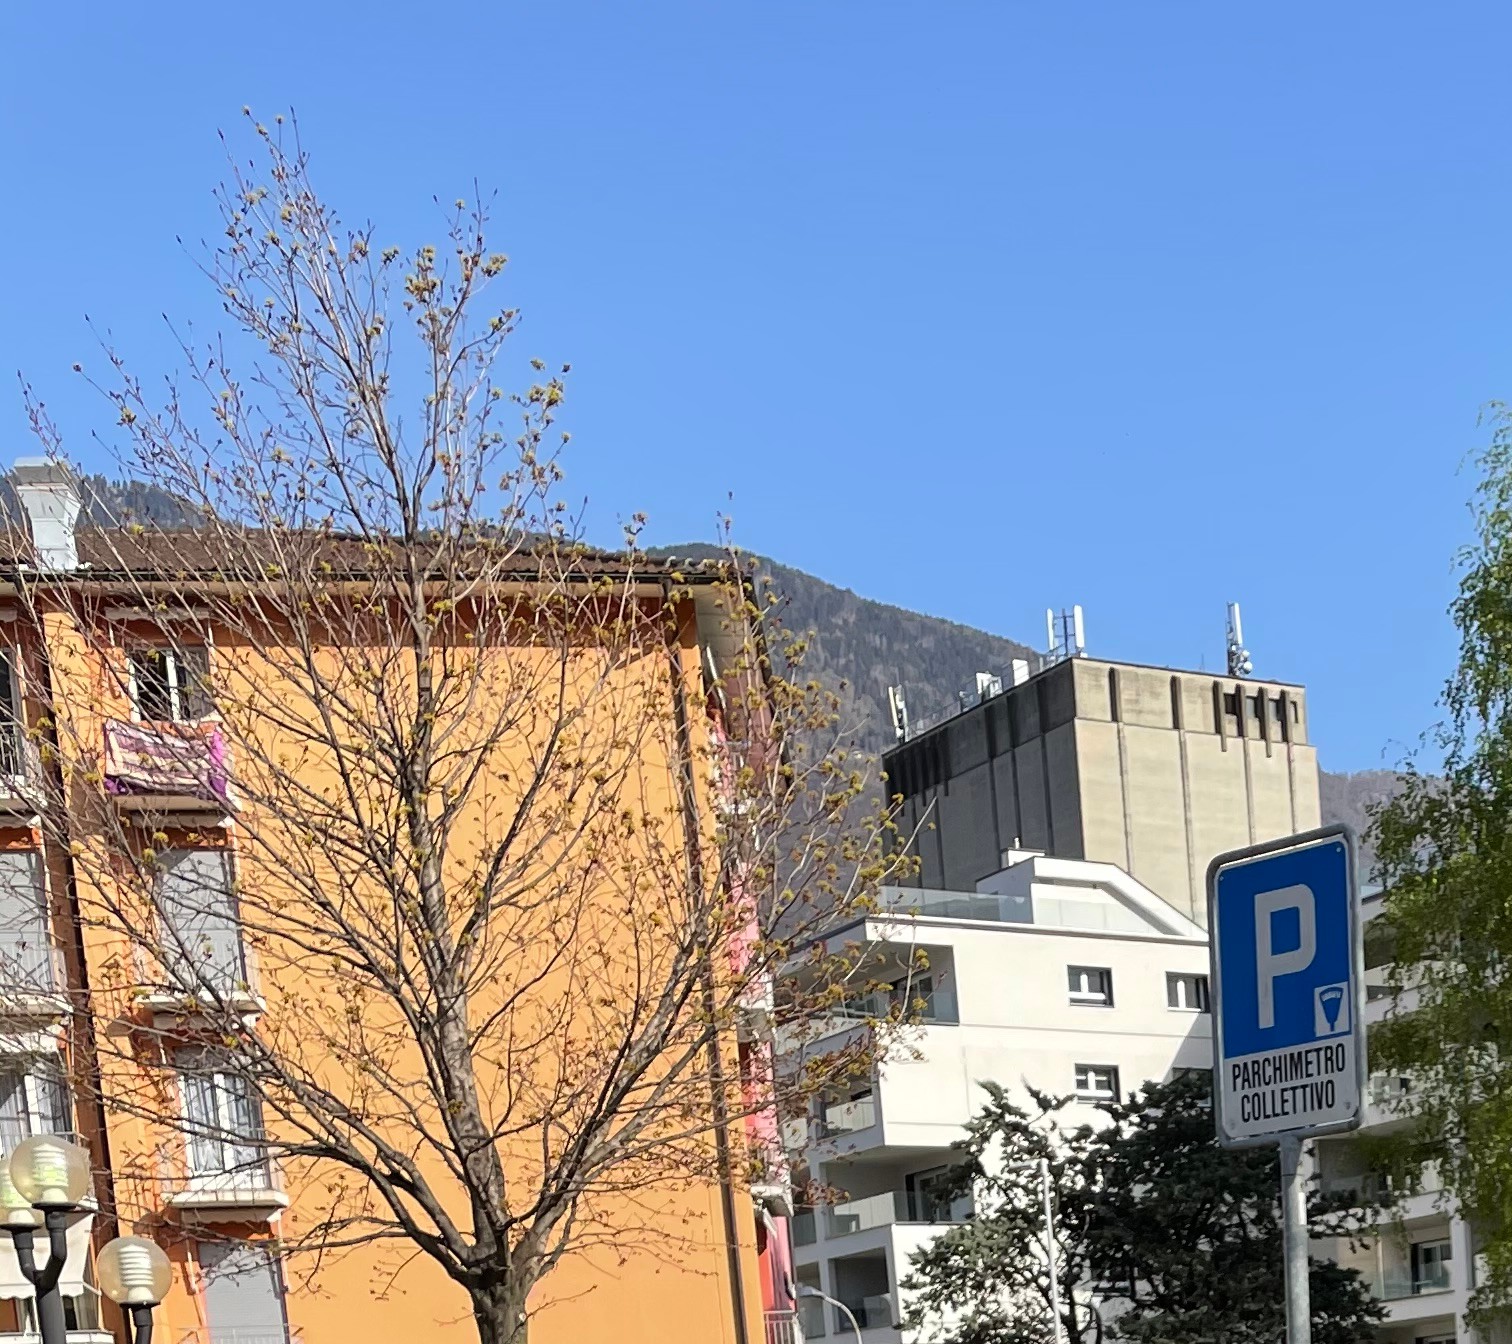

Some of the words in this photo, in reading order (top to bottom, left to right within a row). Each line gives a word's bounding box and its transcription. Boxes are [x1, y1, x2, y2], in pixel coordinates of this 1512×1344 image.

[1255, 883, 1316, 1029] P
[1232, 1043, 1346, 1092] PARCHIMETRO
[1241, 1079, 1335, 1123] COLLETTIVO
